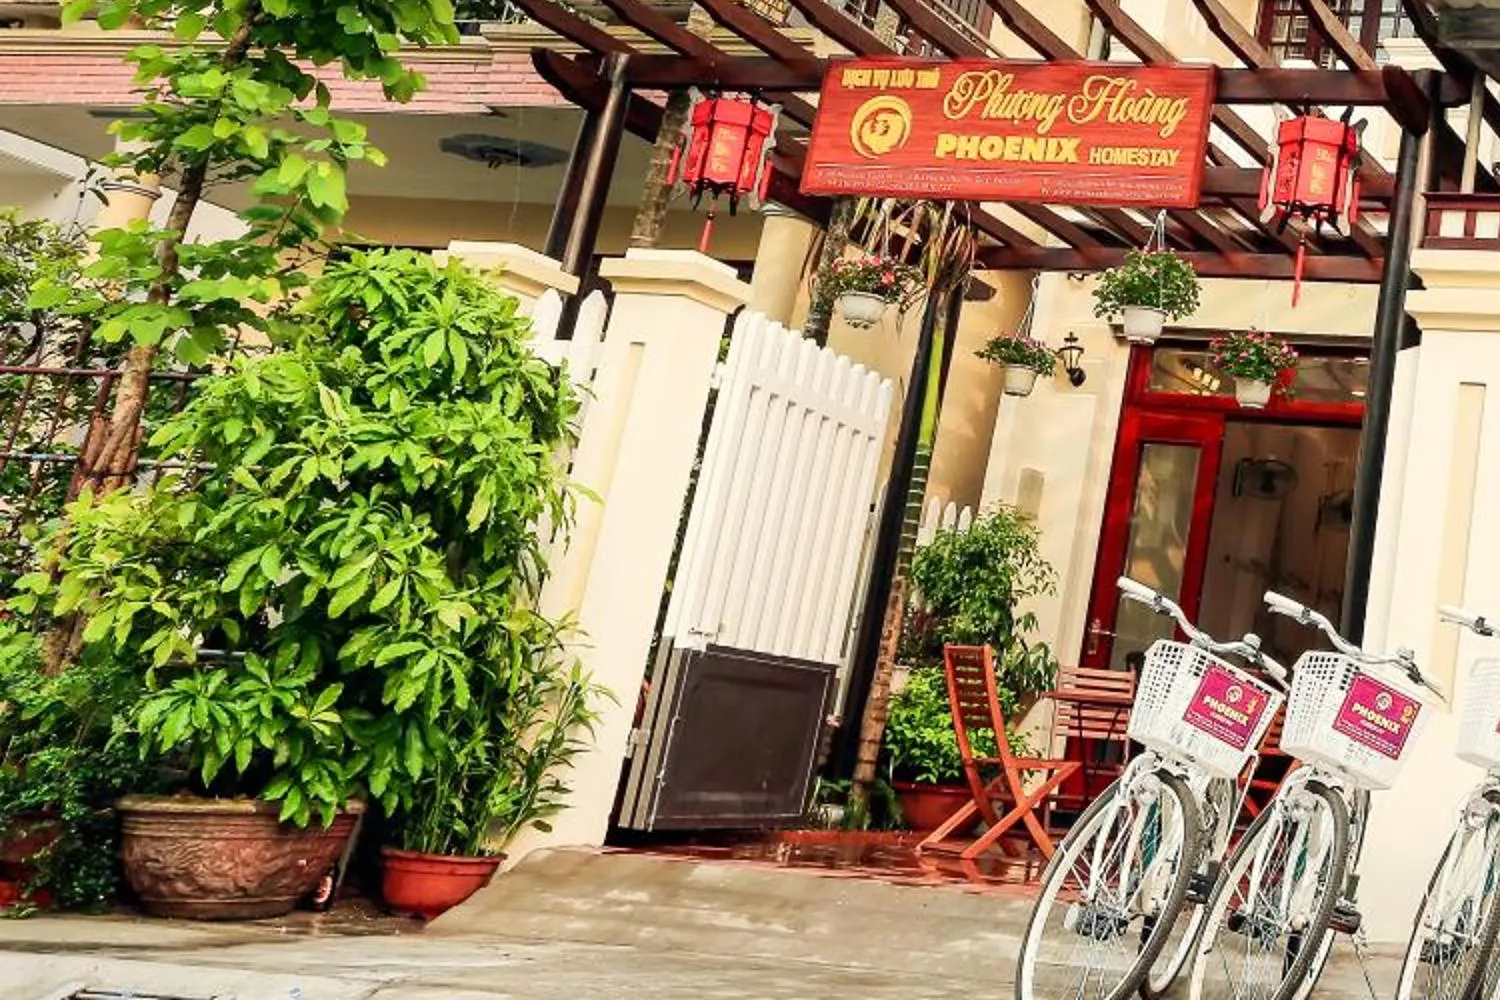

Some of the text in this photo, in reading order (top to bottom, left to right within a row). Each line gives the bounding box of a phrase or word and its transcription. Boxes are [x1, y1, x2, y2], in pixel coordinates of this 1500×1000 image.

[943, 69, 1189, 139] Phượng Hoàng
[933, 133, 1181, 168] PHOENIX HOMESTAY
[1202, 695, 1250, 727] PHOENIX
[1351, 702, 1401, 735] PHOENIX
